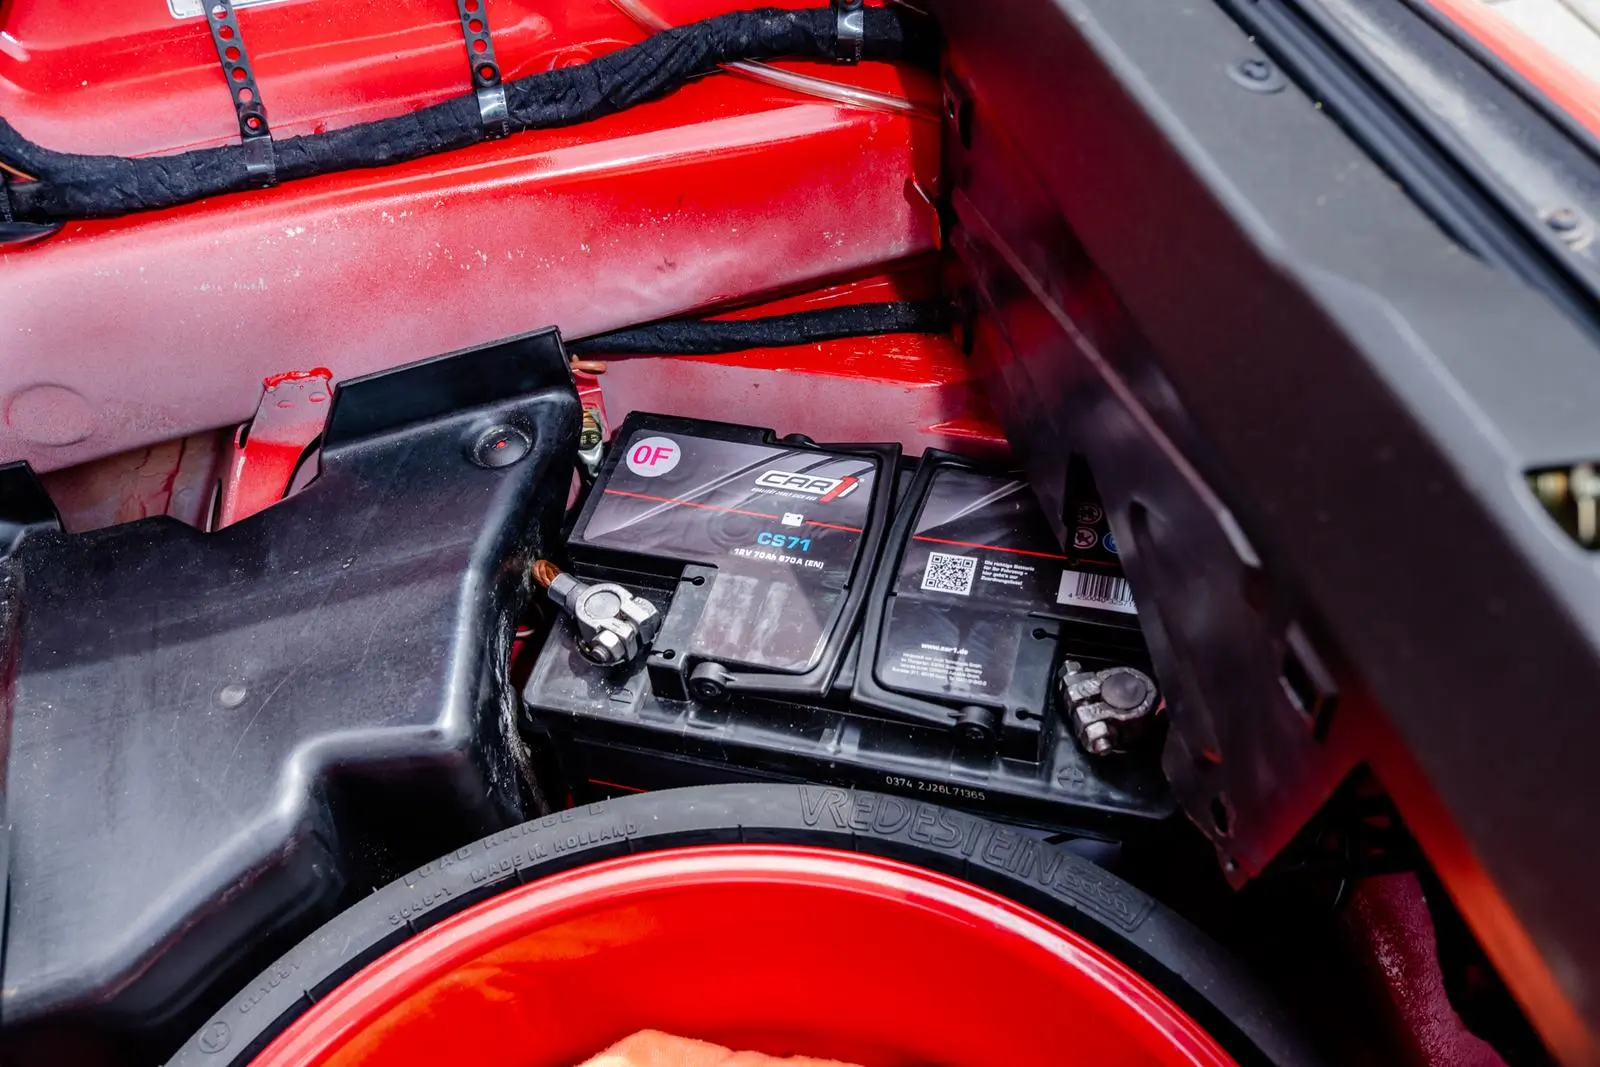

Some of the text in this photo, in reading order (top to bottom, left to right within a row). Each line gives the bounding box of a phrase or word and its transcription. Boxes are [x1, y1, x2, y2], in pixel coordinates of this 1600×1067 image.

[761, 472, 860, 503] CAR1
[757, 532, 812, 552] CS71
[754, 551, 777, 561] 70Ah
[804, 559, 825, 569] (EN)
[885, 775, 913, 788] 0374
[798, 784, 1066, 886] VREDESTEIN
[470, 822, 641, 884] MADE IN HOLLAND
